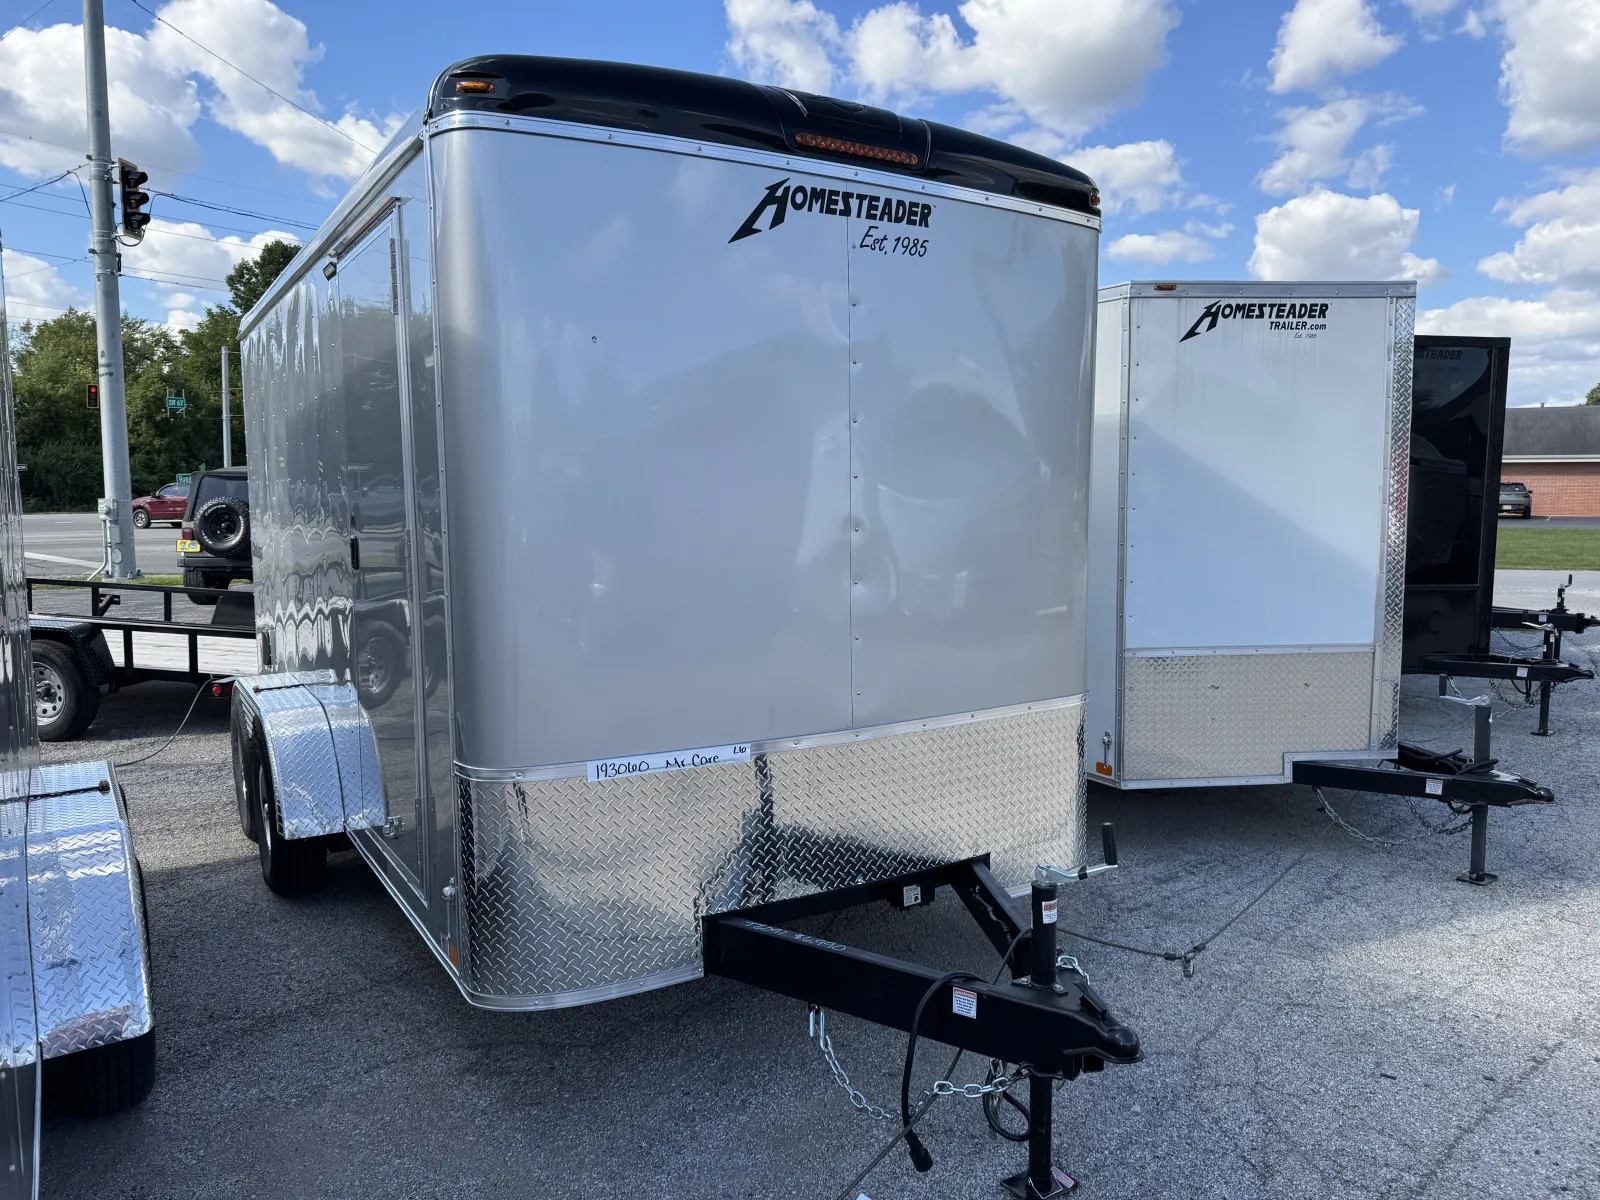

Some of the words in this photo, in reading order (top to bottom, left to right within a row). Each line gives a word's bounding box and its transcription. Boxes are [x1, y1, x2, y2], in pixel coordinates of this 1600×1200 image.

[728, 177, 932, 244] HOMESTEADER
[892, 236, 930, 258] 1985
[1178, 299, 1329, 343] HOMESTEADER
[1269, 321, 1327, 331] TRAILER.com
[595, 760, 650, 780] 193060
[665, 757, 686, 769] Mr
[691, 753, 721, 767] Care
